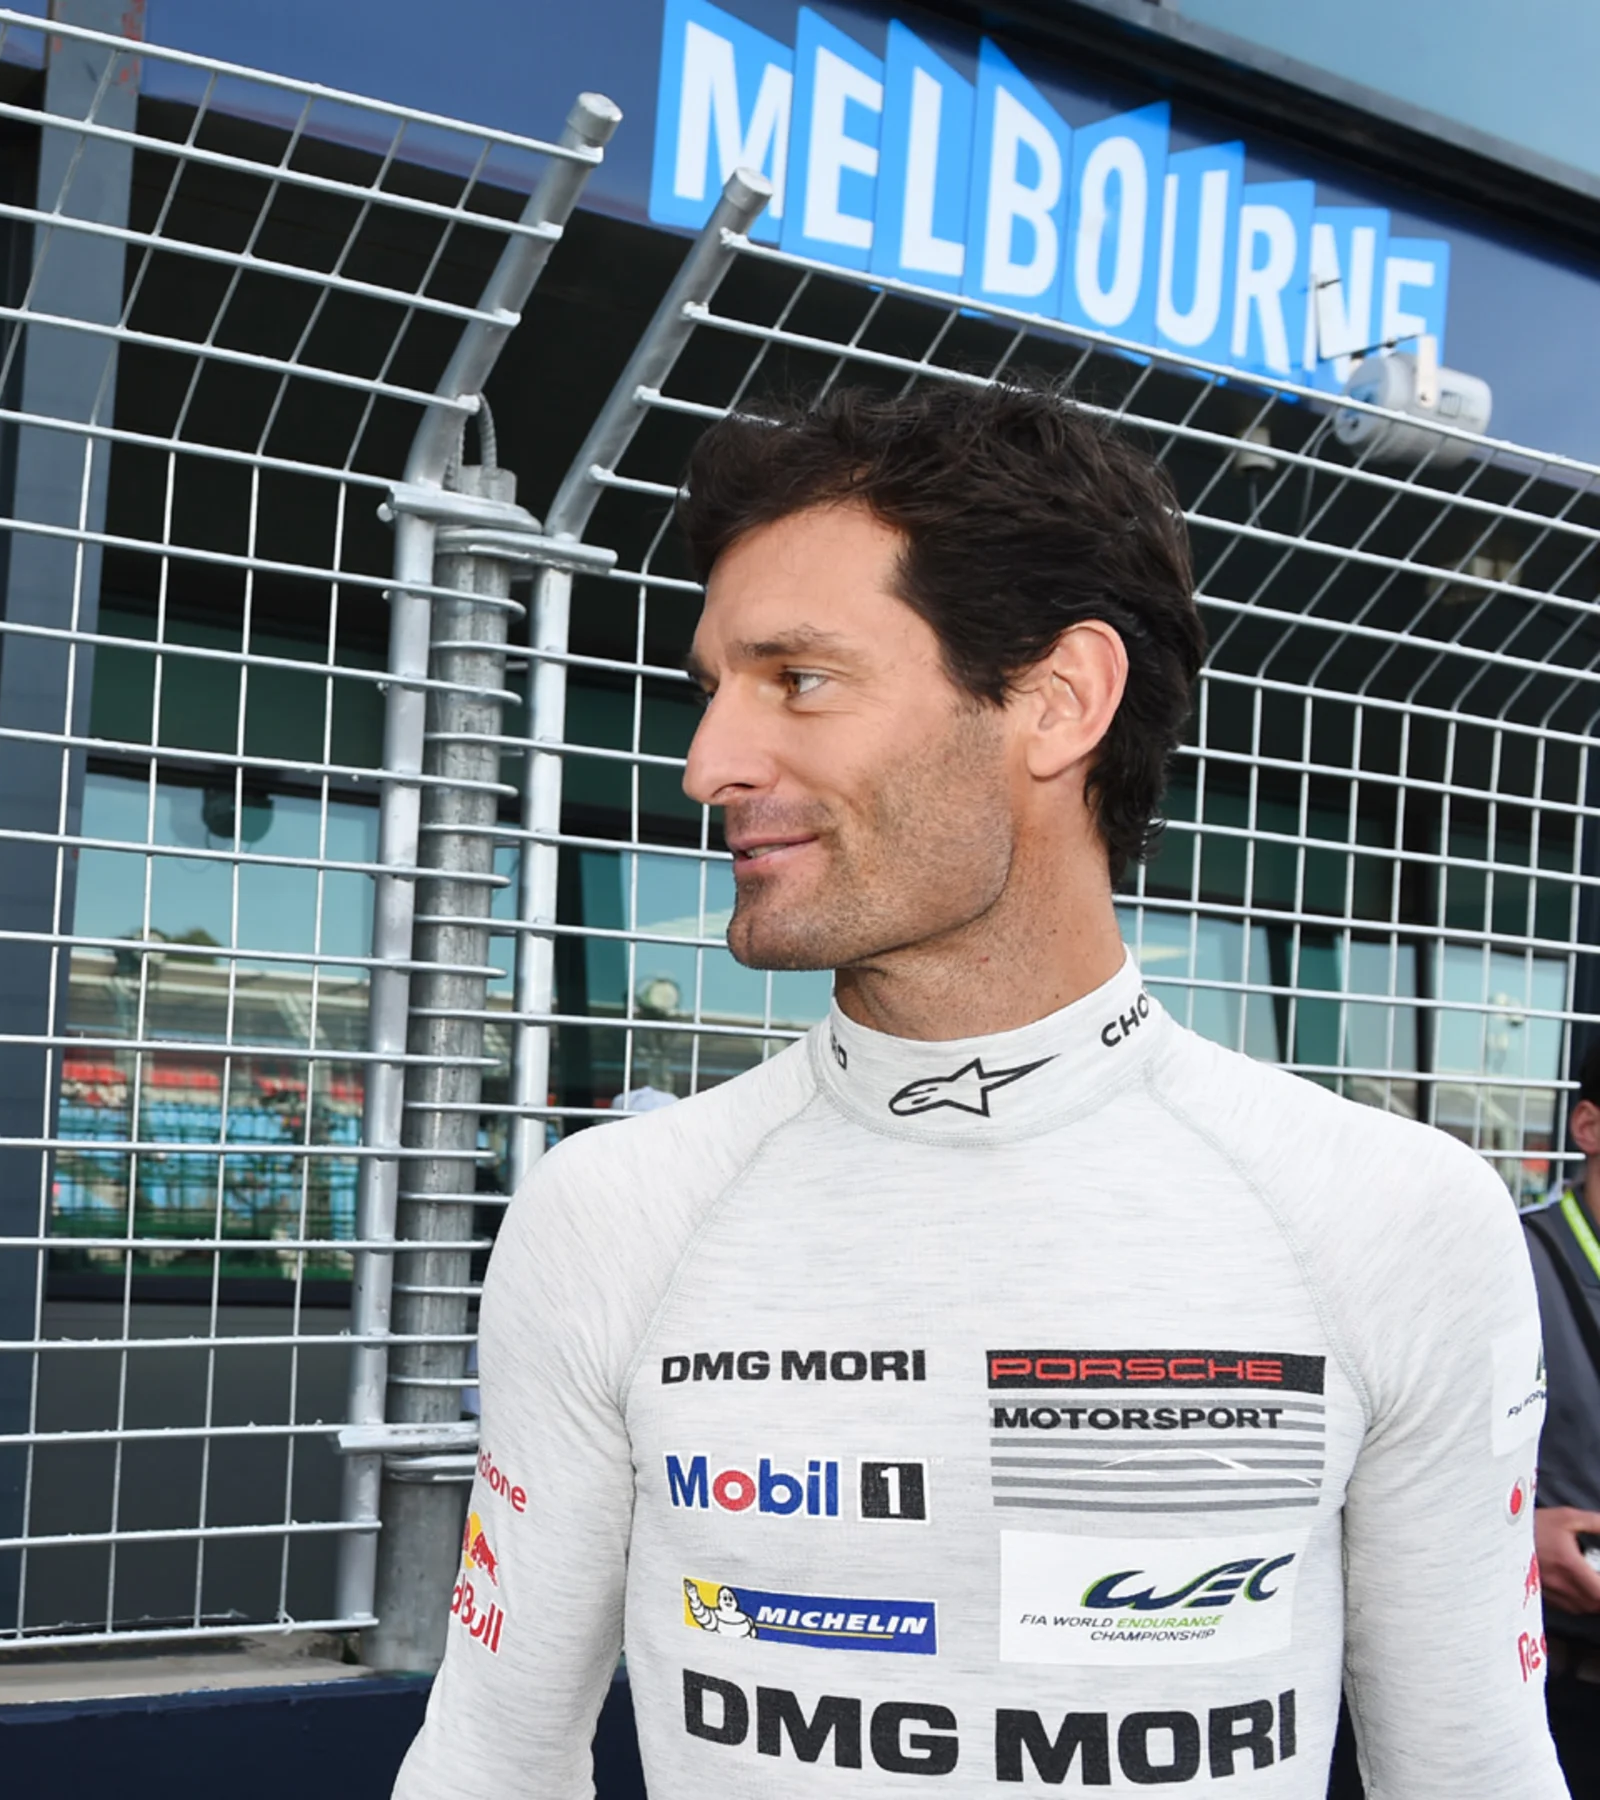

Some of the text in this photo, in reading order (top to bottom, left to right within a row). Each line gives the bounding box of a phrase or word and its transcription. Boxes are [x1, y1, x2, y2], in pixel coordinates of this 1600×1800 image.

[673, 20, 1436, 384] MELBOURNE
[661, 1349, 926, 1384] DMG MORI
[990, 1357, 1283, 1382] PORSCHE
[993, 1407, 1283, 1430] MOTORSPORT
[665, 1455, 840, 1516] Mobil
[756, 1605, 928, 1635] MICHELIN
[1019, 1614, 1224, 1629] FIA WORLD ENDURANCE
[1090, 1628, 1216, 1642] CHAMPIONSHIP
[682, 1668, 1296, 1785] DMG MORI
